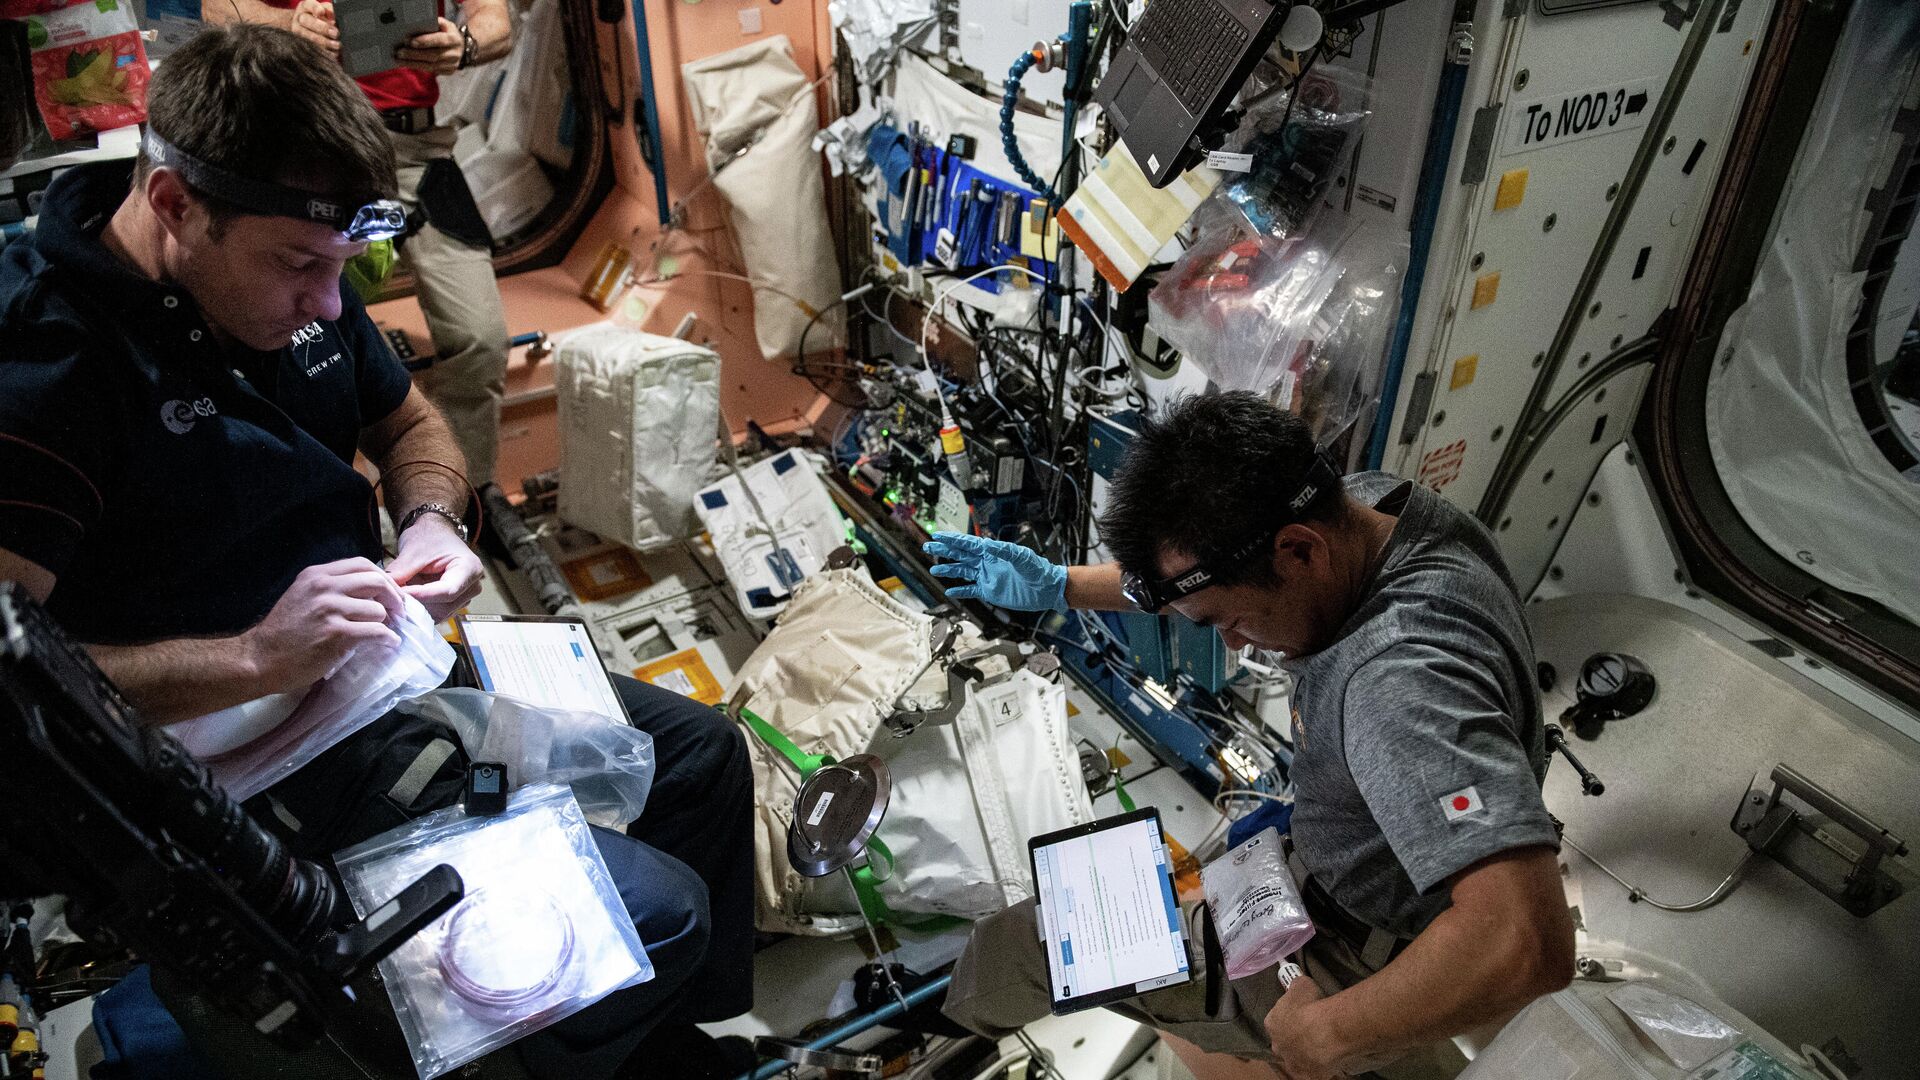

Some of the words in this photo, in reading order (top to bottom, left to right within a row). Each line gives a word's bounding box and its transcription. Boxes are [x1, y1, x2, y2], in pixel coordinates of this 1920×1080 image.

[1524, 103, 1552, 144] To
[1554, 91, 1608, 138] NOD
[1609, 88, 1625, 126] 3
[291, 321, 324, 347] NASA
[306, 360, 328, 377] CREW
[328, 352, 342, 364] TWO
[1290, 485, 1317, 508] PETZL
[1175, 571, 1212, 593] PETZL
[1001, 701, 1011, 716] 4
